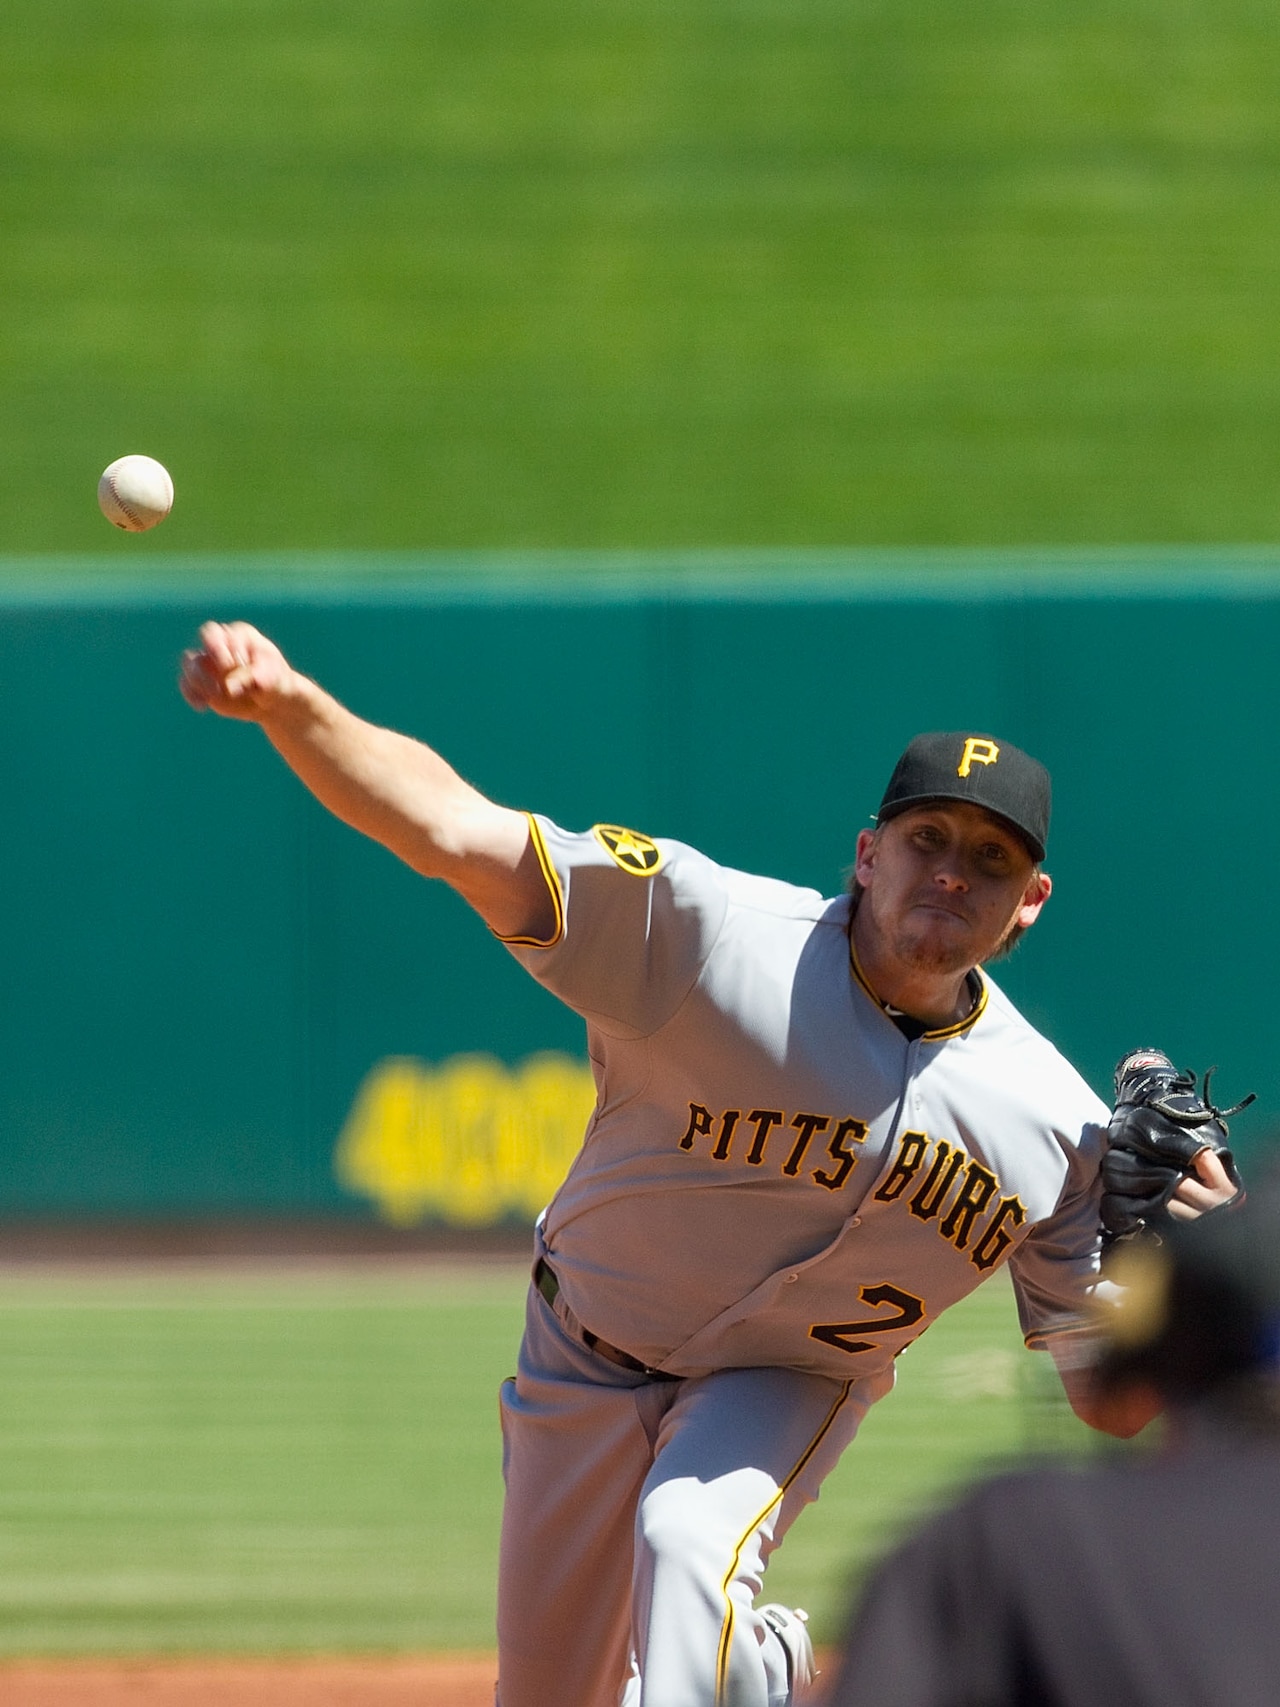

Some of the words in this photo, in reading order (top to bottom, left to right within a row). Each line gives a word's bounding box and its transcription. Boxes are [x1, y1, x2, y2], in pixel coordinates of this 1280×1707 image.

[957, 737, 1000, 778] P
[678, 1101, 1035, 1272] PITTSBURG
[808, 1281, 930, 1358] 2
